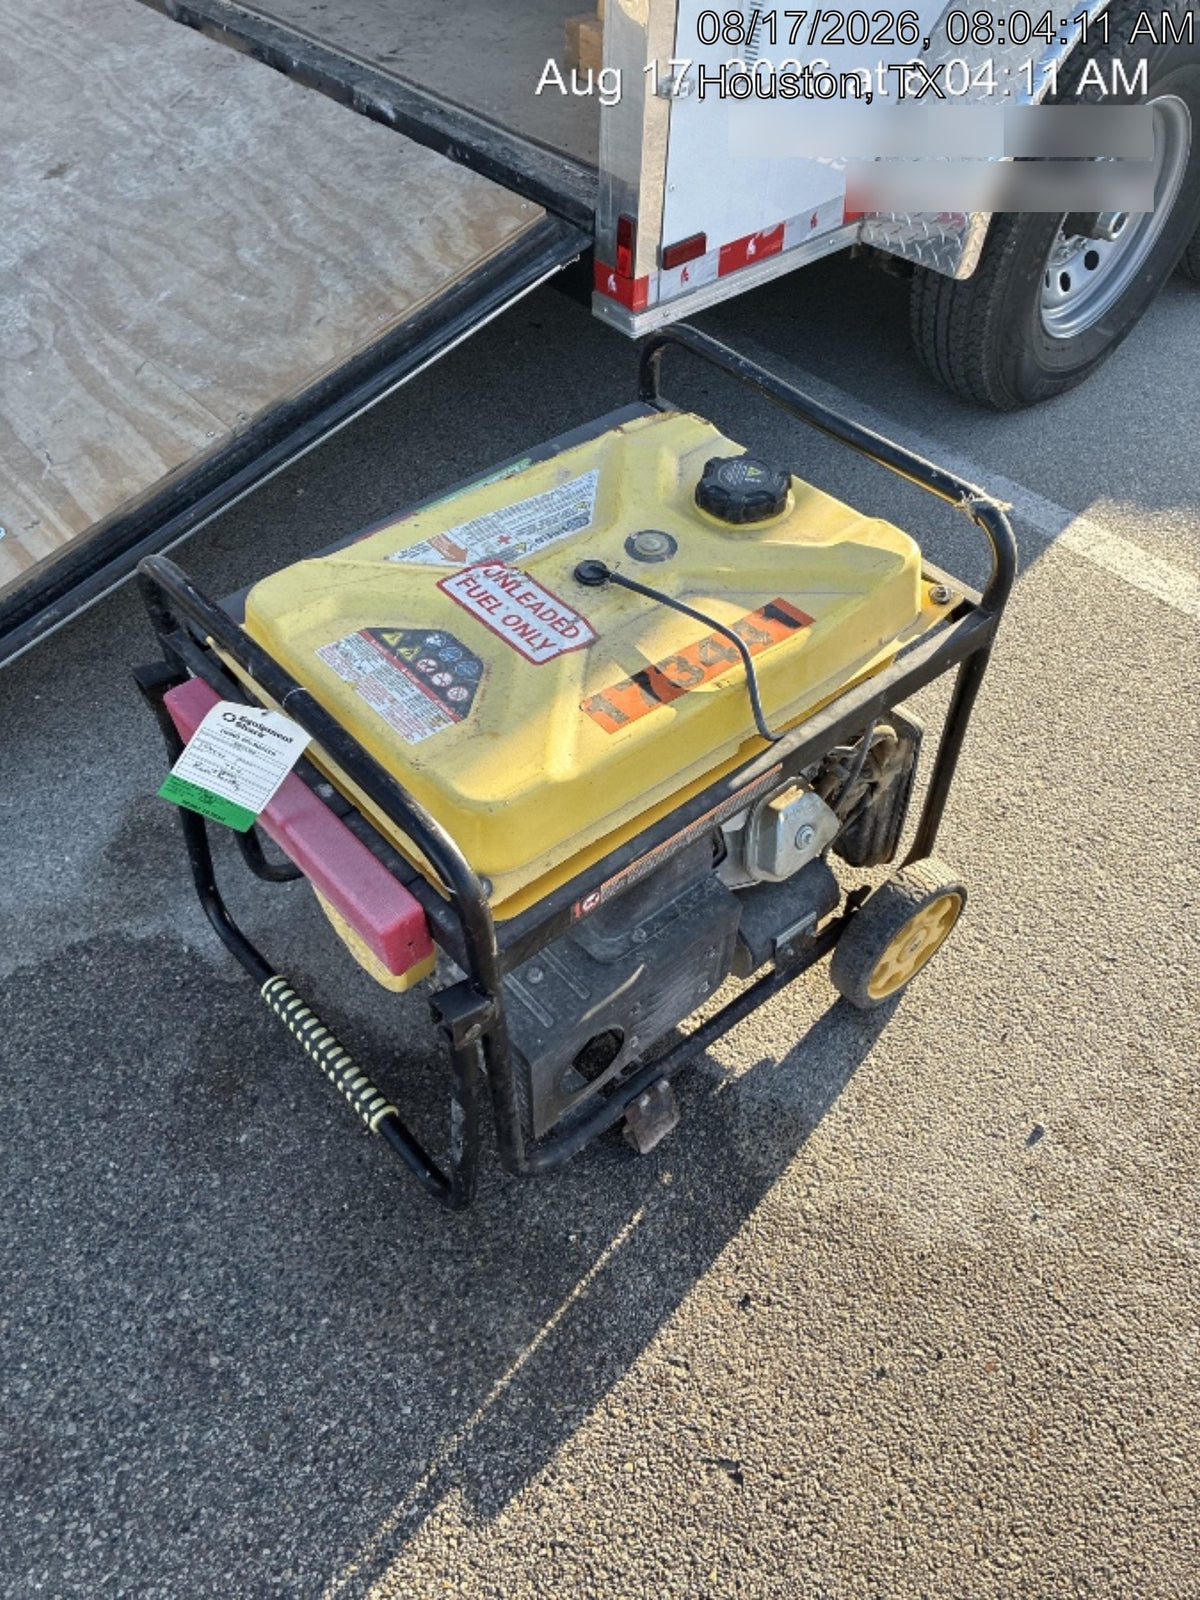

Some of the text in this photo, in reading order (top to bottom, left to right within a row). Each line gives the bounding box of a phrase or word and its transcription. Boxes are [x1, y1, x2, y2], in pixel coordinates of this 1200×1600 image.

[455, 574, 558, 653] FUEL ONLY
[483, 568, 581, 639] UNLEADED
